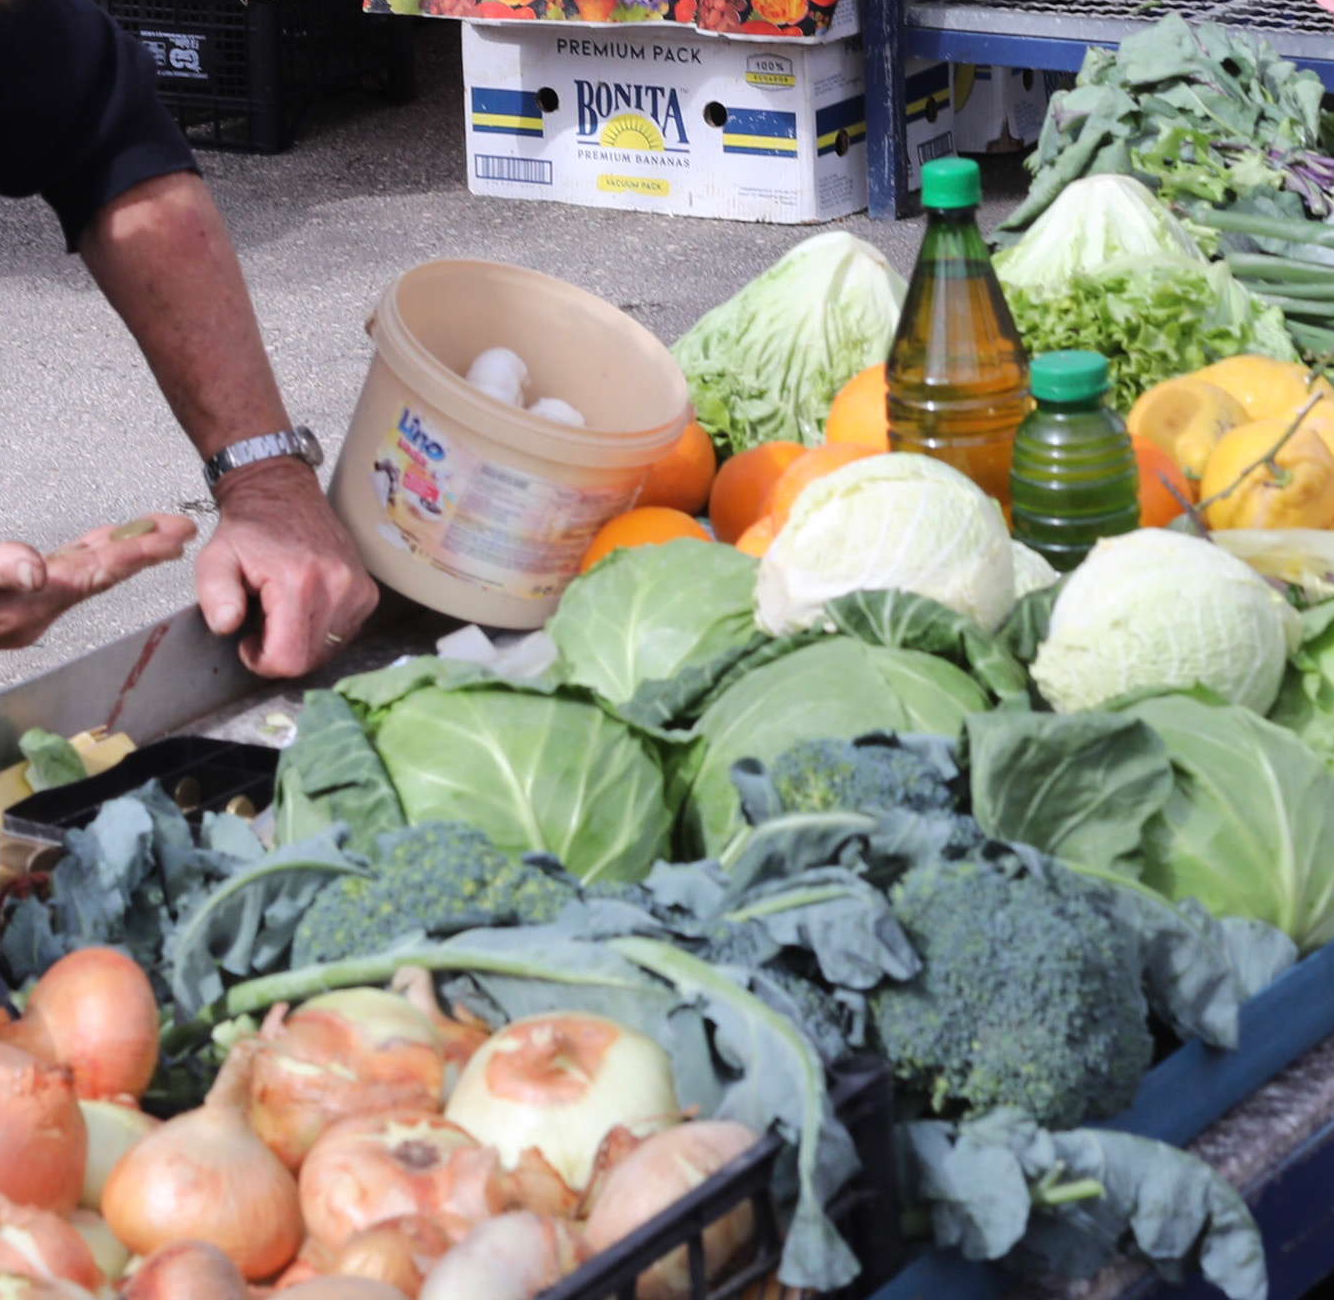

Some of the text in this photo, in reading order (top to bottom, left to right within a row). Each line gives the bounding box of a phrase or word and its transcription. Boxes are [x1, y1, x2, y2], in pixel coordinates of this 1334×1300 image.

[557, 38, 703, 64] PREMIUM PACK
[756, 60, 784, 72] 100%
[574, 79, 691, 144] BONITA
[577, 149, 691, 168] PREMIUM BANANAS
[605, 177, 663, 191] VACUUM PACK
[398, 406, 446, 462] Lino
